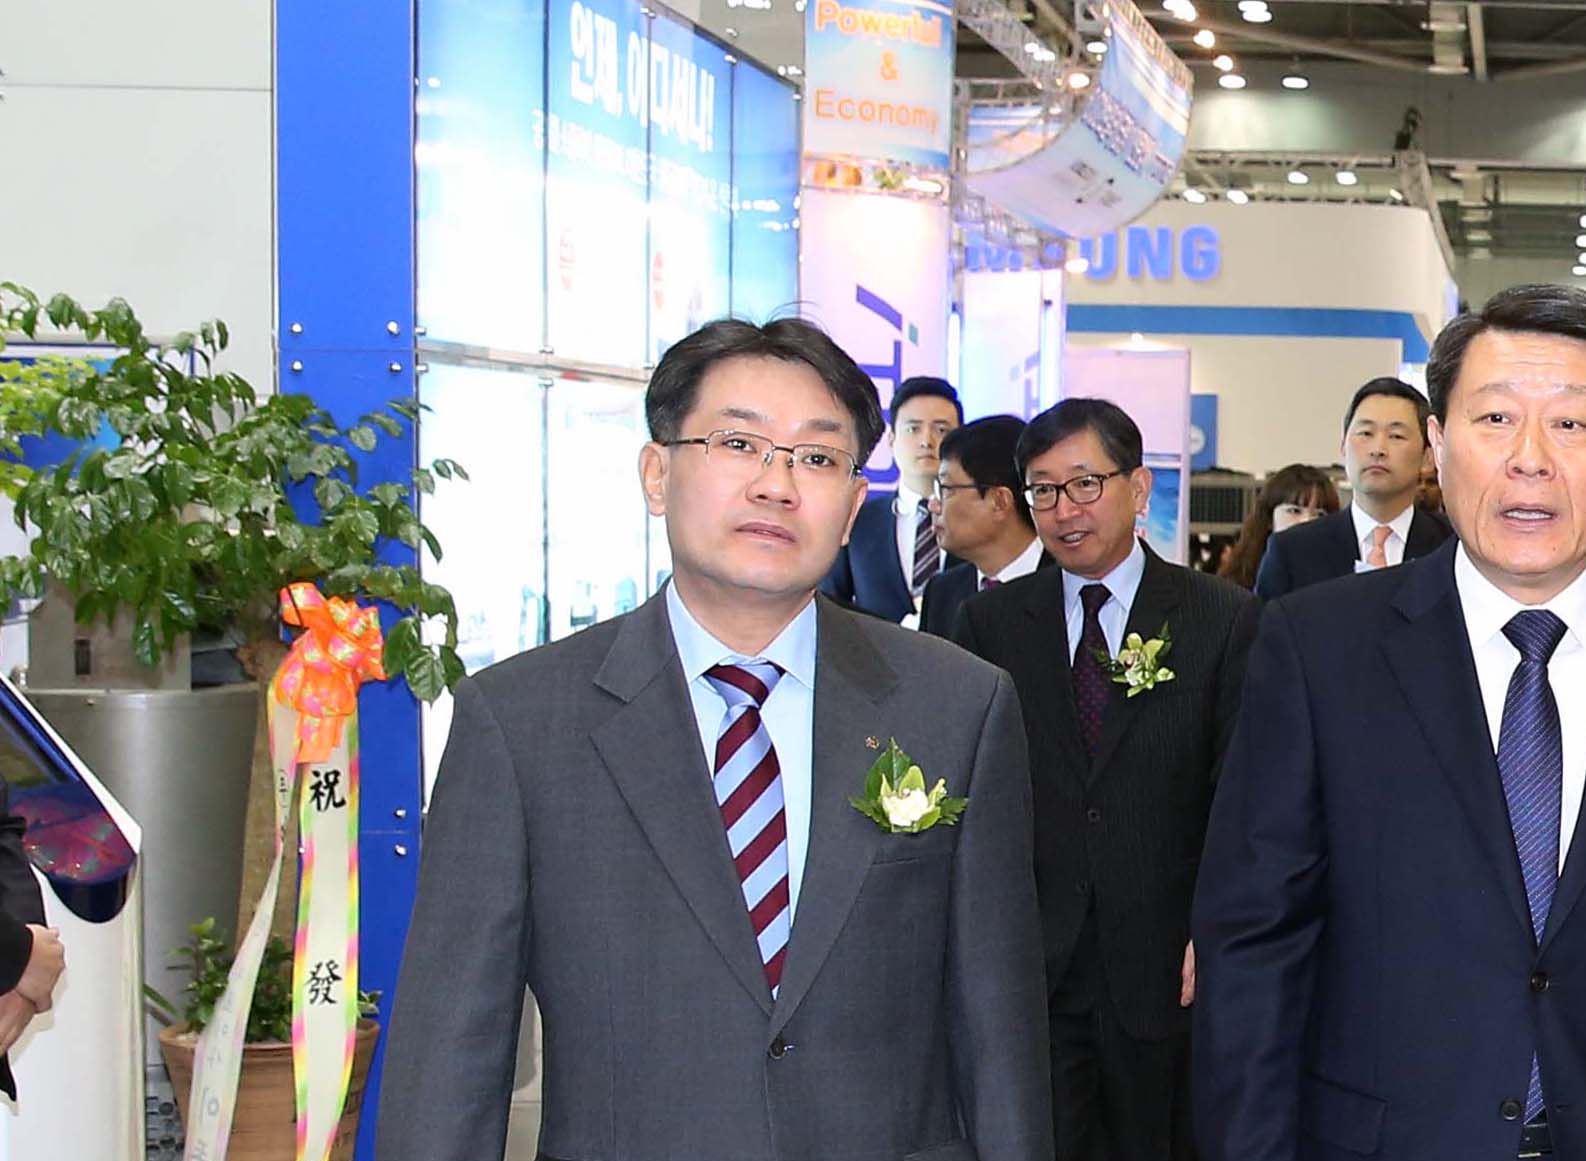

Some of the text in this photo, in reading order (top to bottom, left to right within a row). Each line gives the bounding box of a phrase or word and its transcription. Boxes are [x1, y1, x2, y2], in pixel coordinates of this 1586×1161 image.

[815, 0, 942, 48] Powerful
[880, 50, 899, 81] &
[815, 88, 939, 134] Economy
